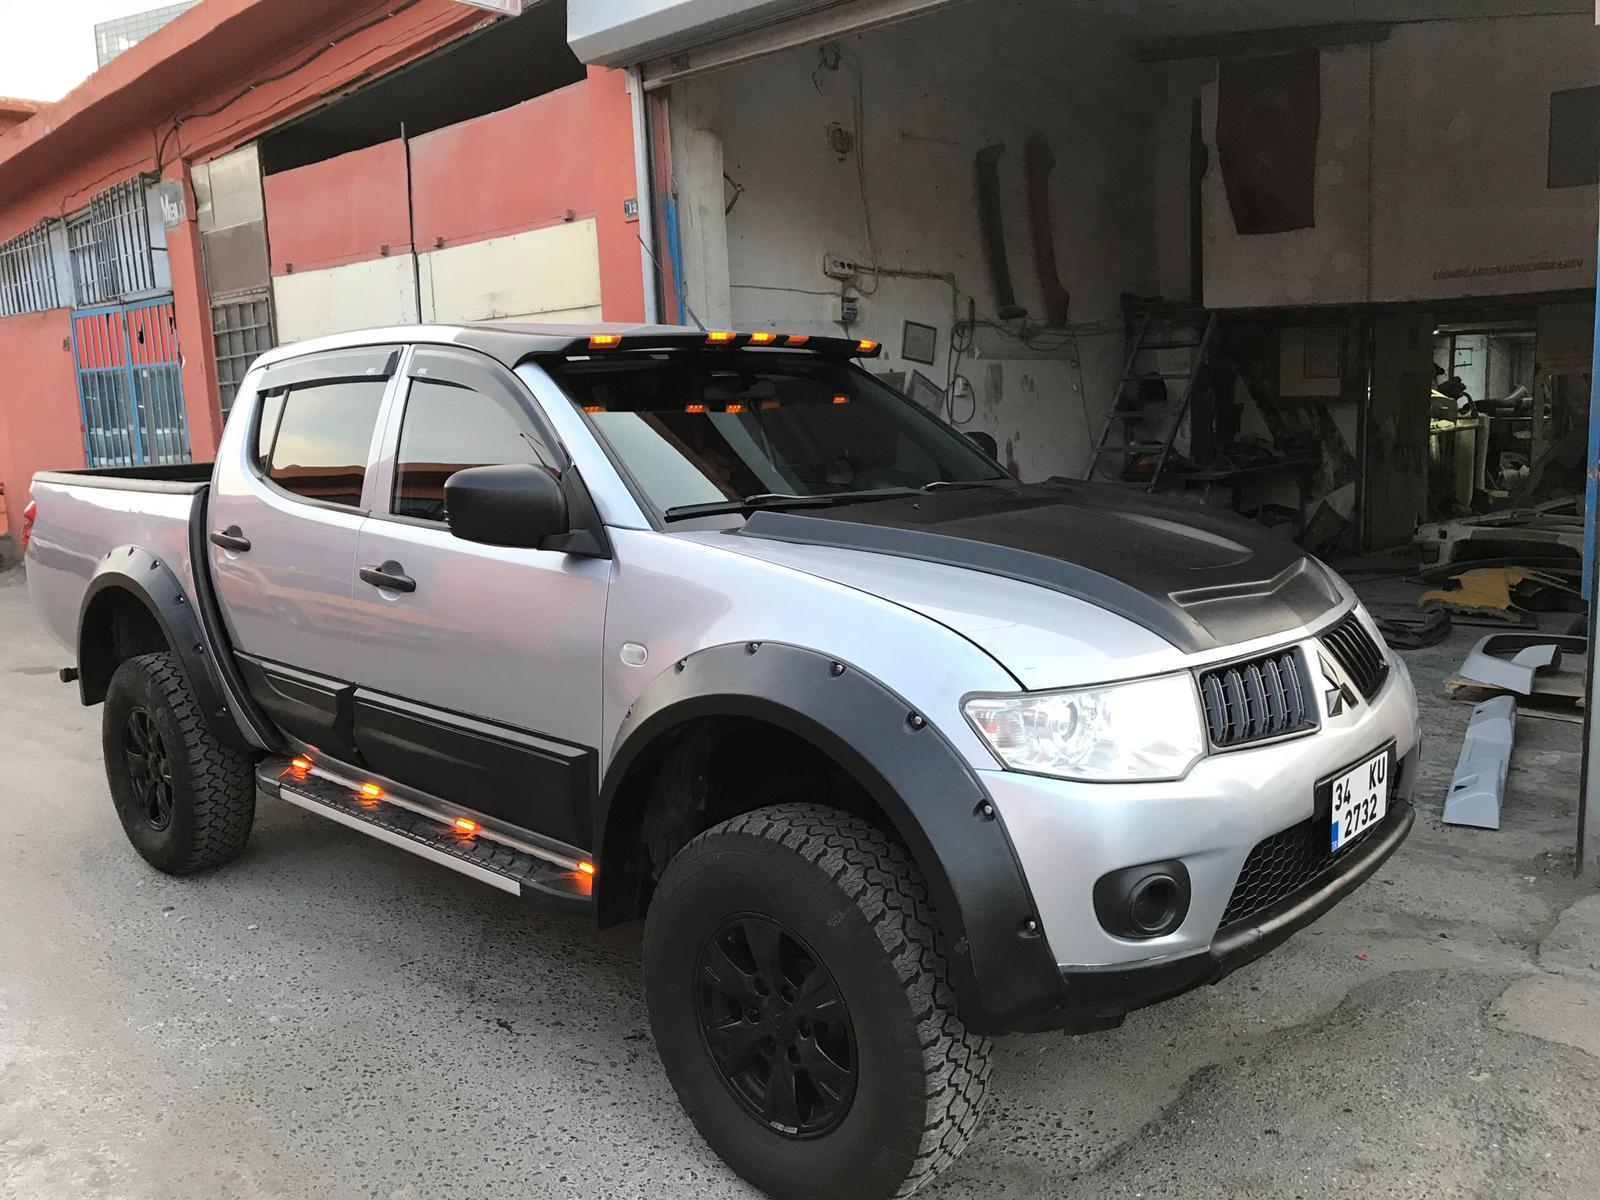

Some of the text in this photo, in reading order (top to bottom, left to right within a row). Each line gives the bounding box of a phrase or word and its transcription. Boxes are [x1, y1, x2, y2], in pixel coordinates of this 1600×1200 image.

[1335, 757, 1386, 811] 34 KU
[1344, 793, 1378, 838] 2732
